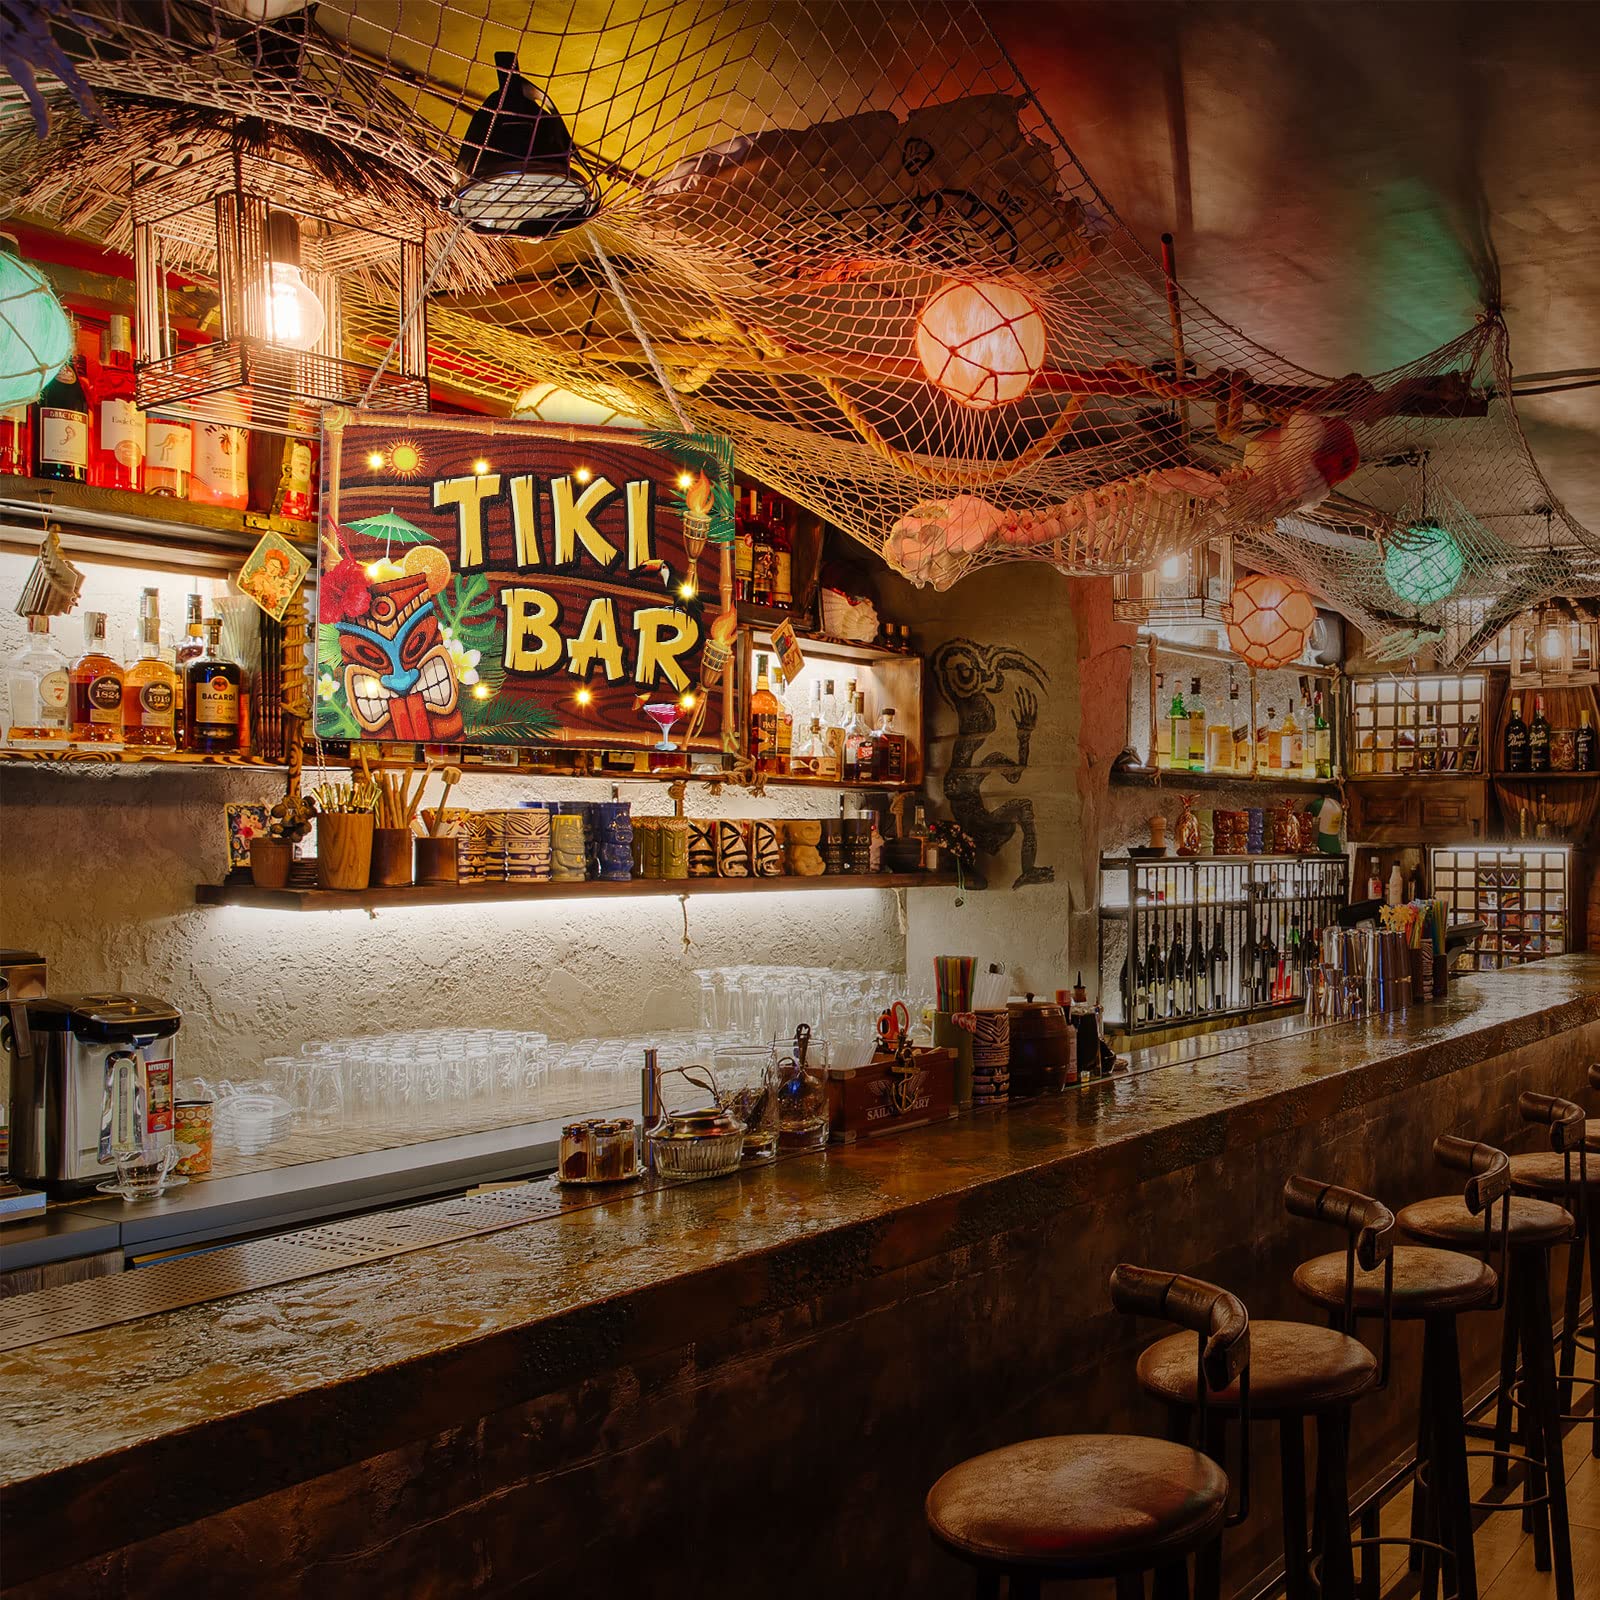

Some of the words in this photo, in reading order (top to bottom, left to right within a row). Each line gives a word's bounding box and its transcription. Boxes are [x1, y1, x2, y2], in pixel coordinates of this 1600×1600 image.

[433, 474, 651, 570] TIKI
[501, 588, 697, 692] BAR
[95, 690, 120, 699] 1824
[148, 695, 170, 703] 1919
[216, 704, 224, 715] 8
[867, 1106, 894, 1121] SAILO
